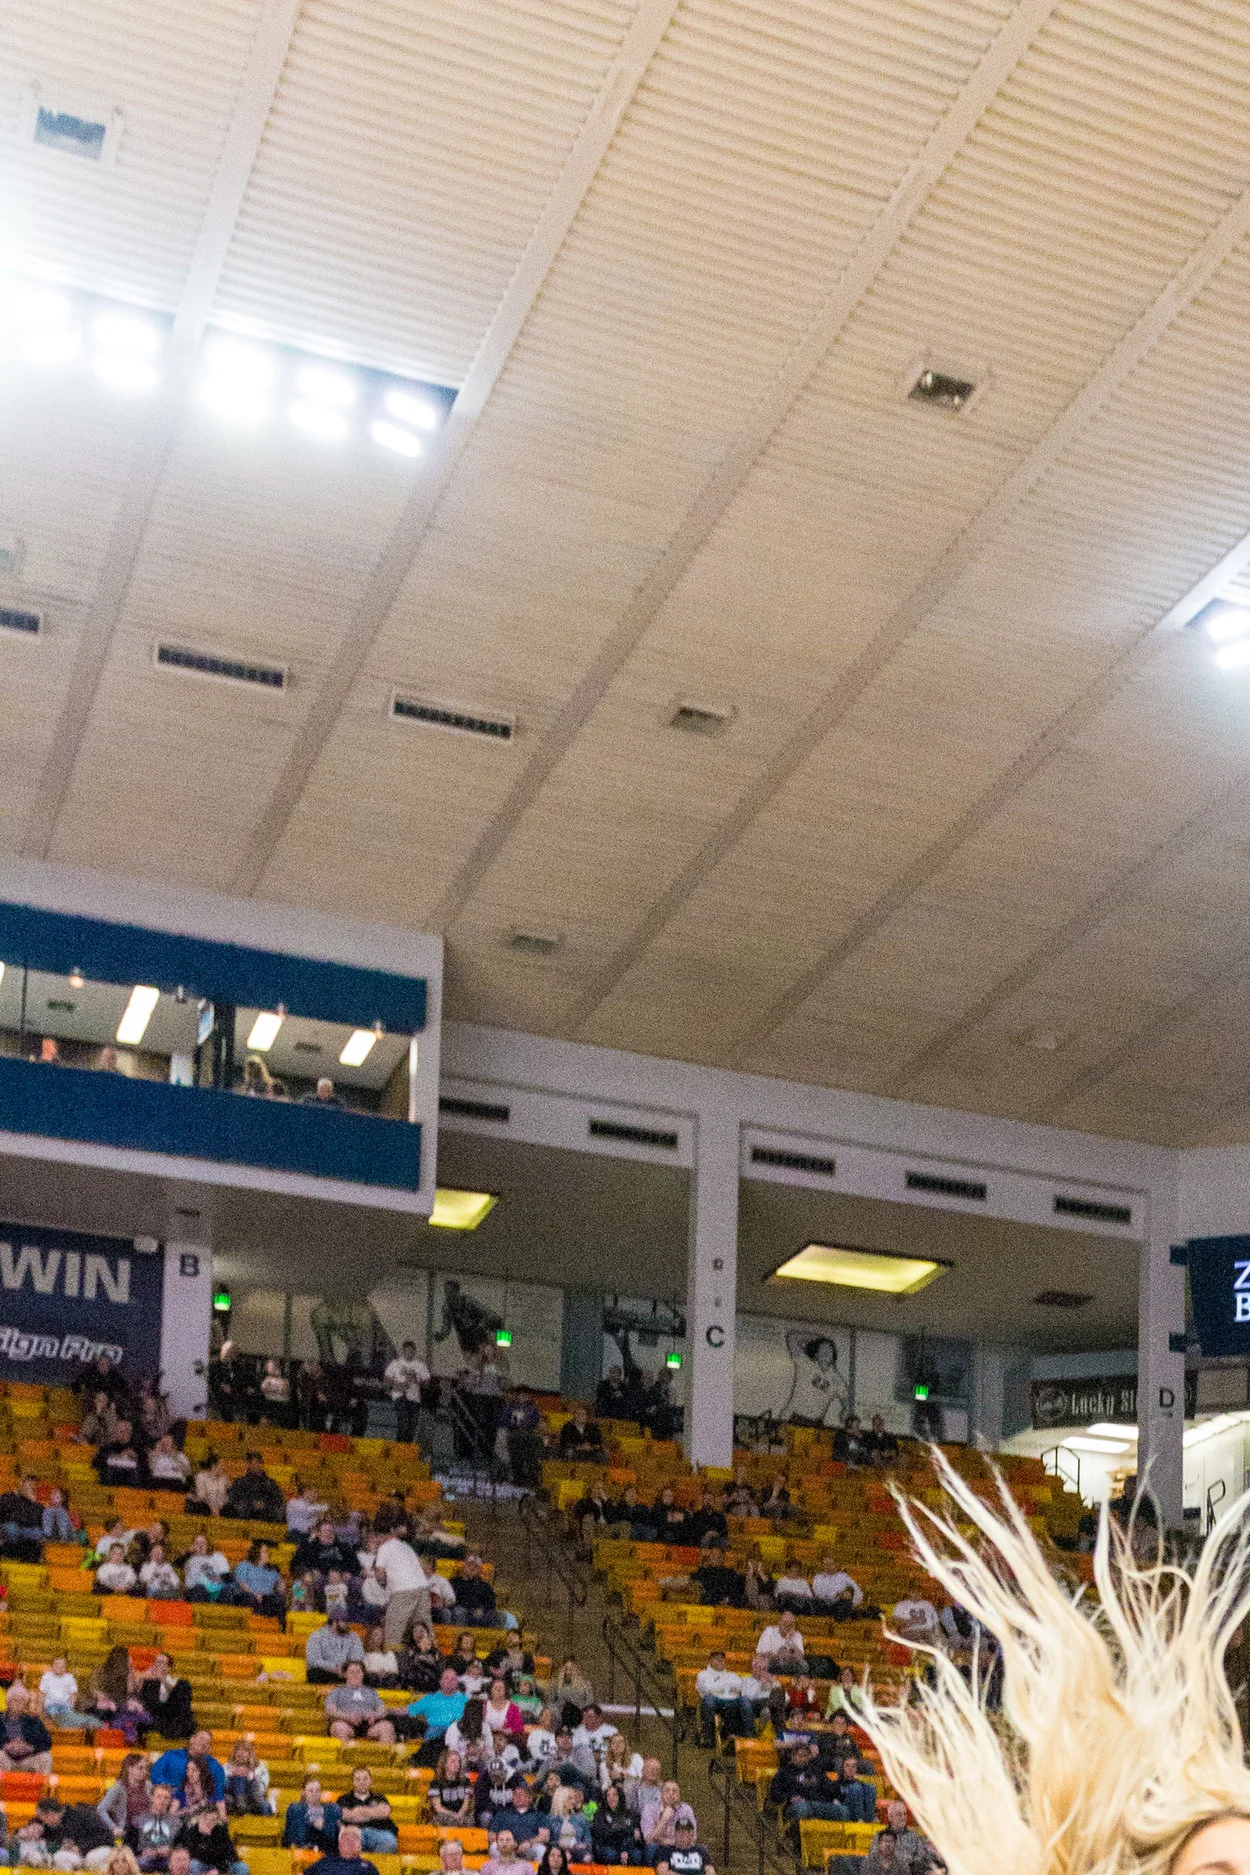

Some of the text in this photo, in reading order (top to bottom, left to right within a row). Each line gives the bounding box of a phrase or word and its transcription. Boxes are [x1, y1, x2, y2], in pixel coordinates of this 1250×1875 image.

[0, 1241, 131, 1304] WIN
[179, 1253, 200, 1278] B
[706, 1325, 726, 1350] C
[1158, 1386, 1176, 1409] D
